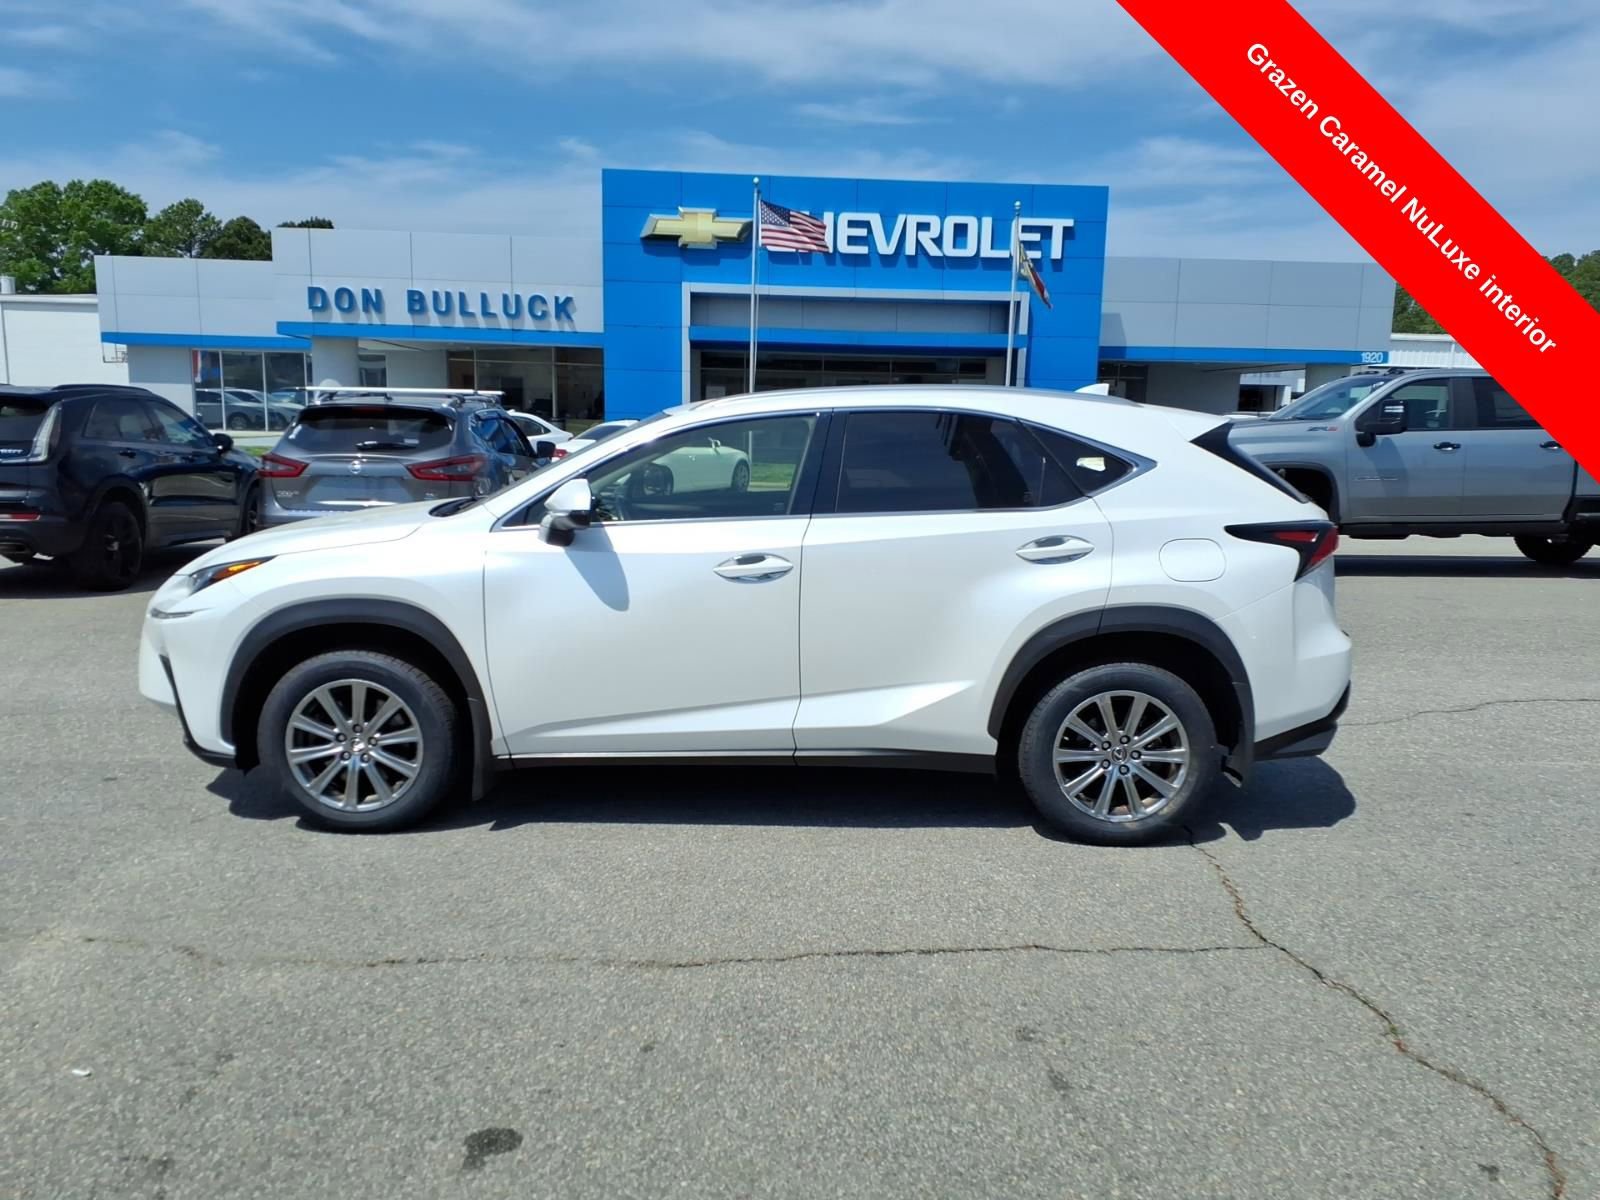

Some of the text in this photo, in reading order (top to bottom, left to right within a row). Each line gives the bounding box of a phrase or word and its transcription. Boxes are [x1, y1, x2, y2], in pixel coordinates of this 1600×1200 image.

[766, 210, 1074, 259] HEVROLET
[307, 286, 574, 321] DON BULLUCK
[1361, 351, 1384, 364] 1920
